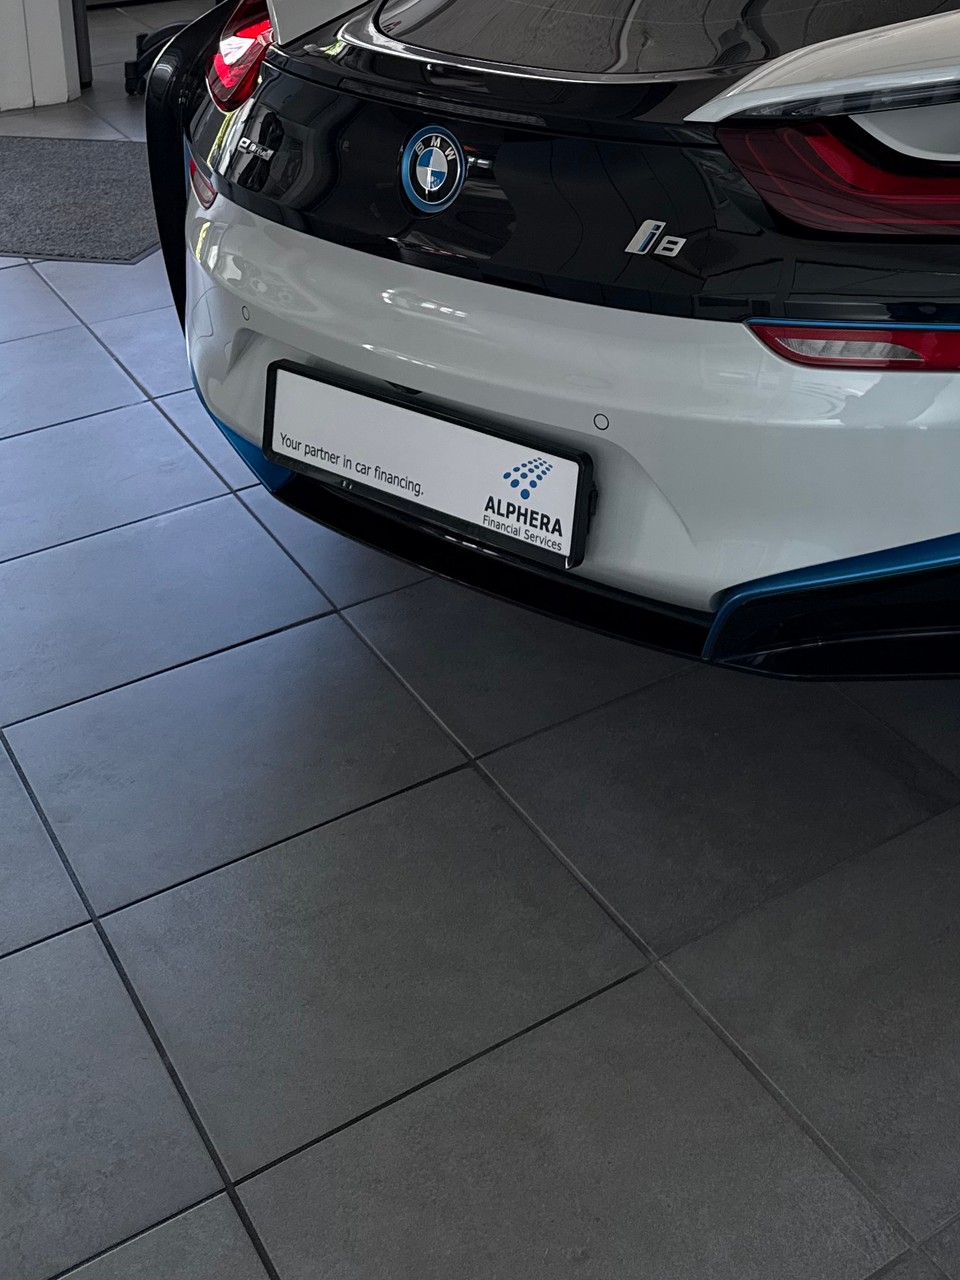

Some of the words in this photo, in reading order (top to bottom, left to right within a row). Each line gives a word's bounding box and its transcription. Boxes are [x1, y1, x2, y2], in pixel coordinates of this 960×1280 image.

[415, 136, 456, 161] BMW
[624, 219, 688, 258] i8
[280, 431, 302, 452] Your
[304, 443, 340, 467] partner
[343, 454, 353, 471] in
[355, 459, 372, 475] car
[374, 465, 425, 497] financing.
[483, 514, 521, 537] Financial
[523, 527, 563, 552] Services
[484, 495, 563, 538] ALPHERA
